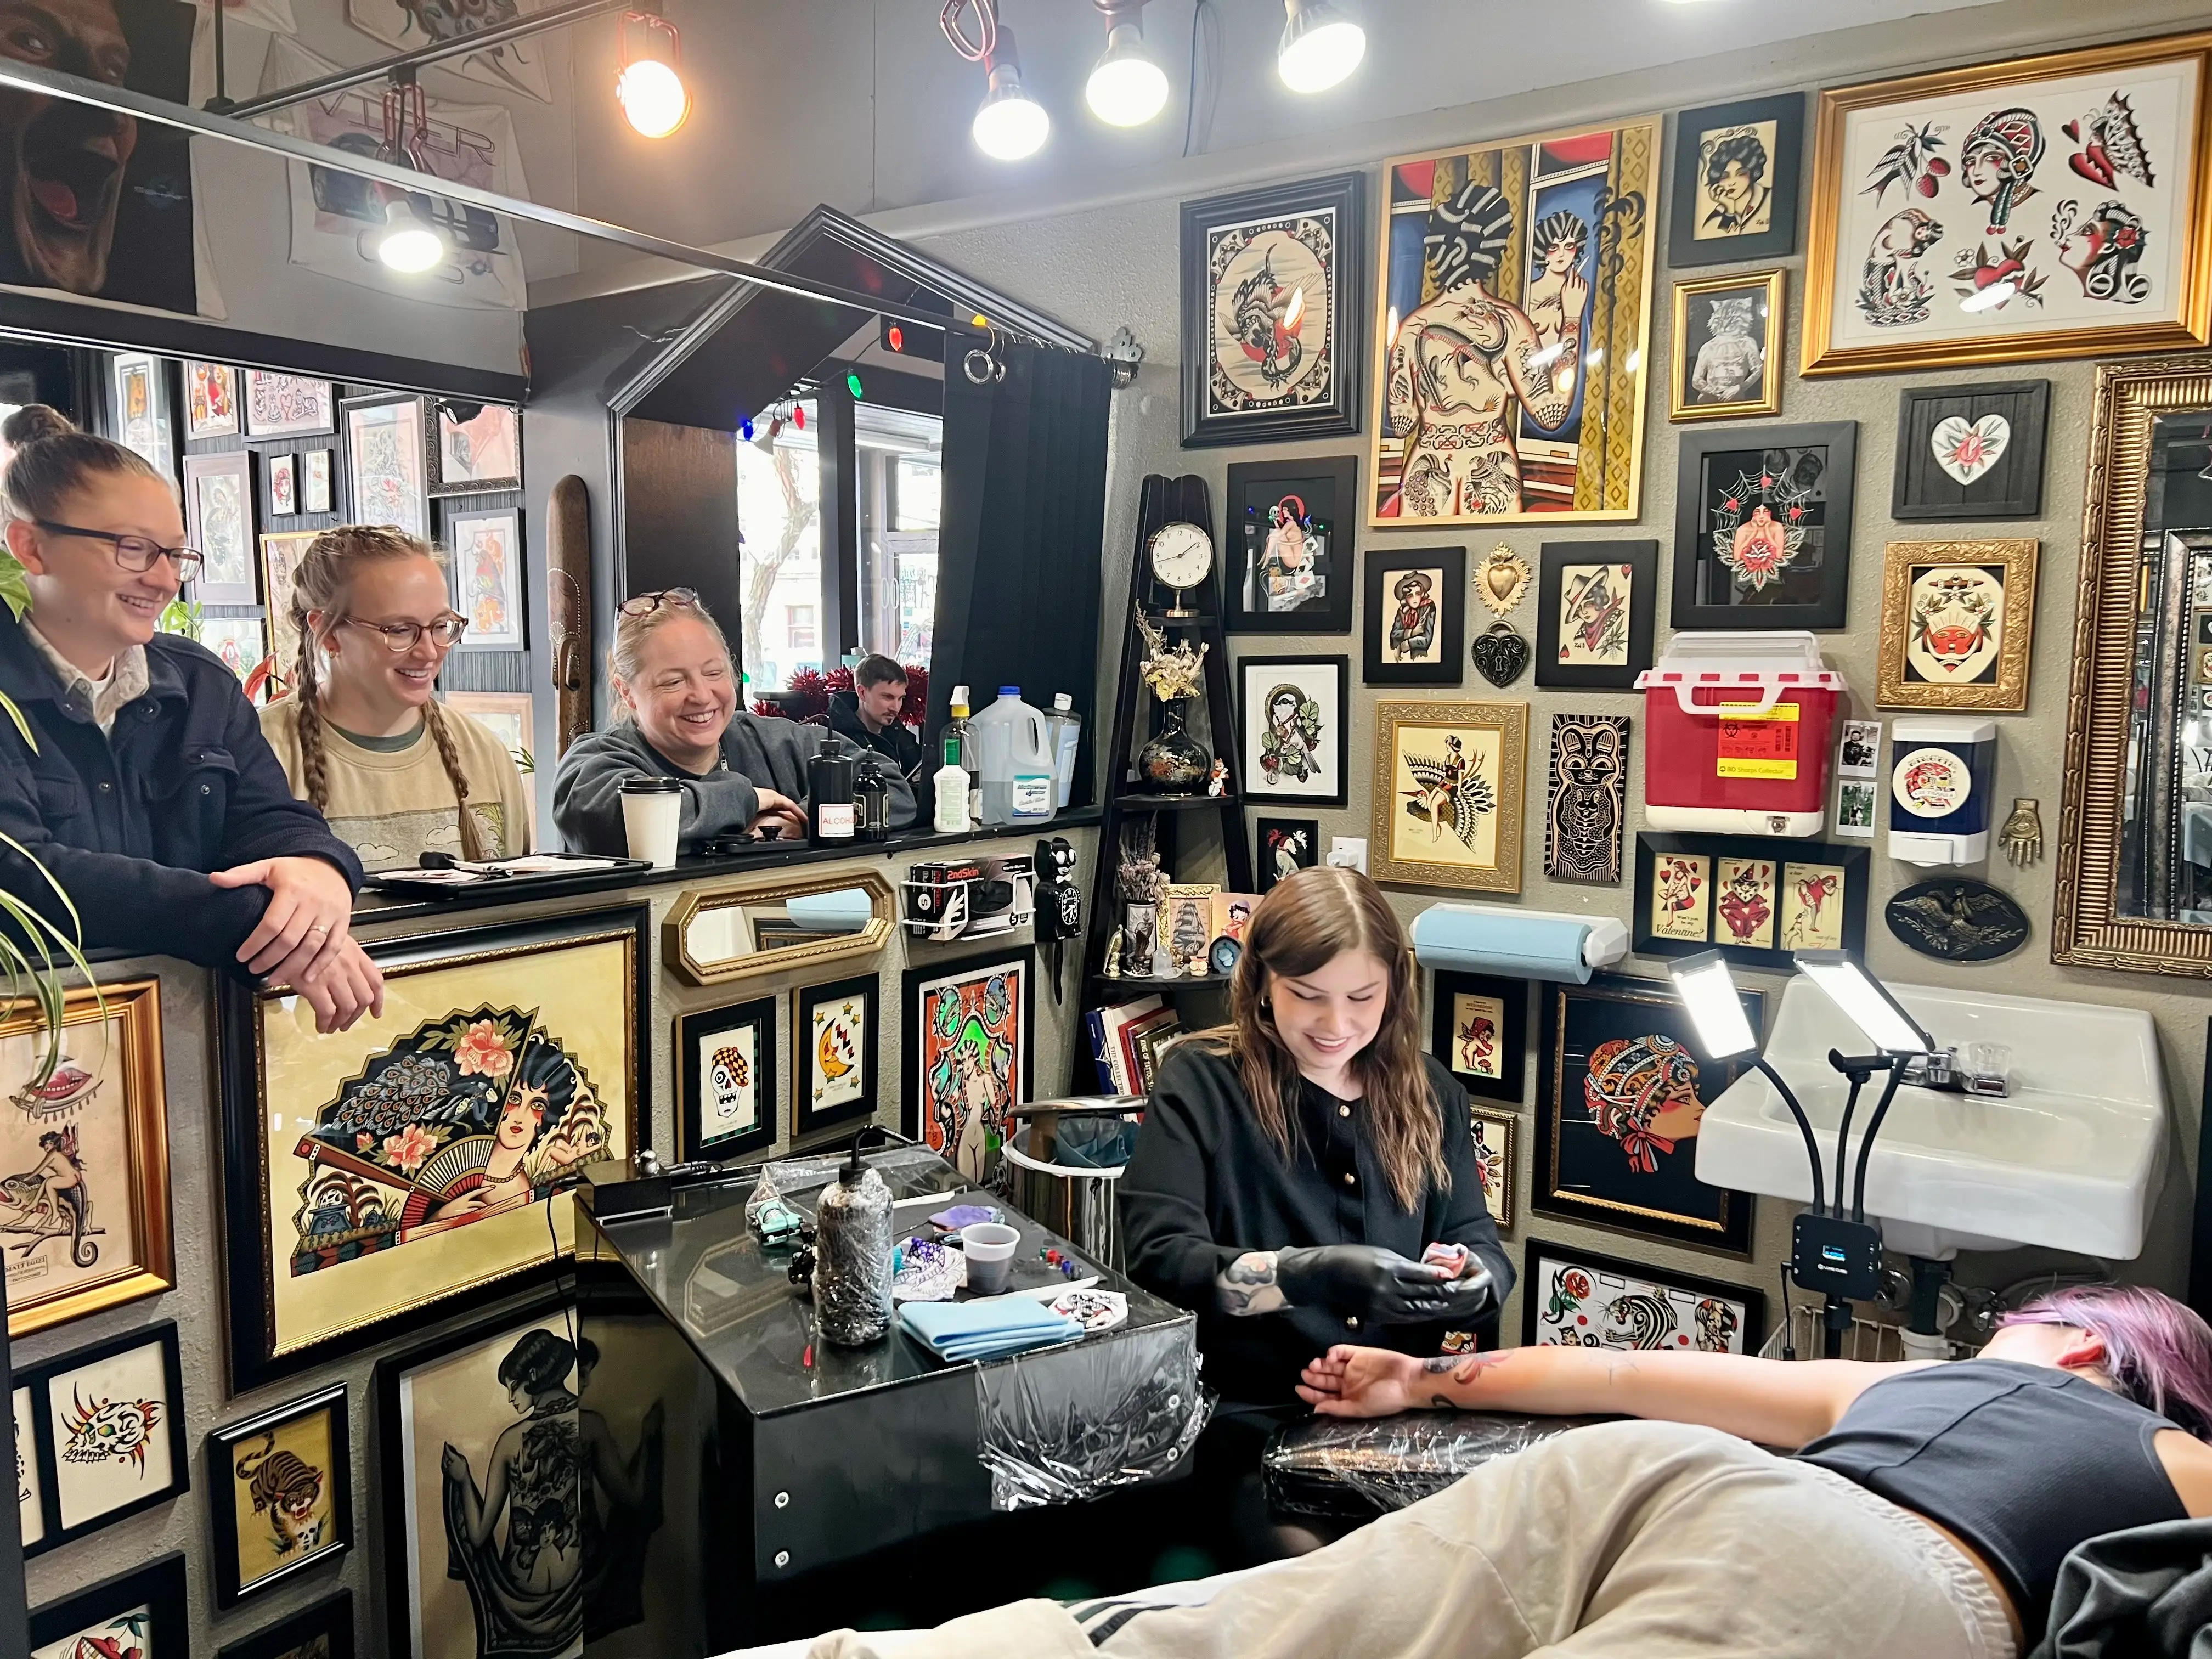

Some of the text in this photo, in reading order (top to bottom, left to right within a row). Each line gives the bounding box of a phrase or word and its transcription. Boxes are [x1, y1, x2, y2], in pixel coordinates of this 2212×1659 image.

[947, 867, 979, 880] 2ndSkin
[1011, 915, 1017, 923] S
[1656, 923, 1705, 938] Valentine?
[1139, 1040, 1148, 1053] KING
[5, 1262, 25, 1273] MATT
